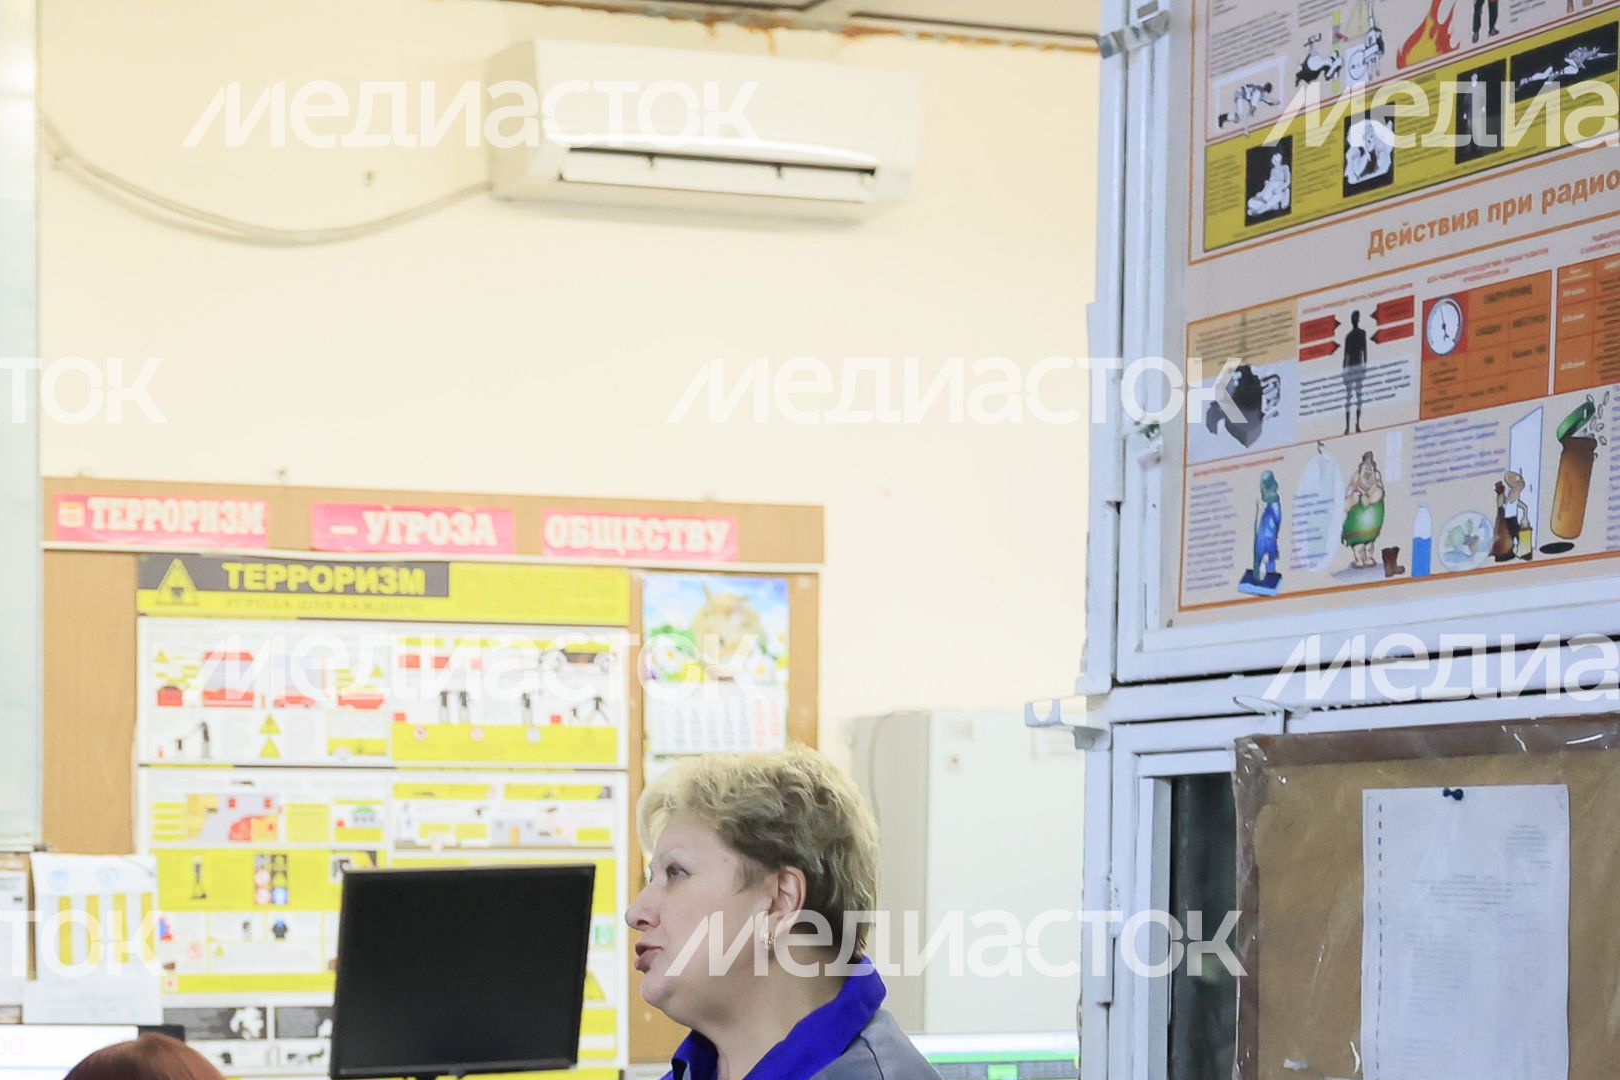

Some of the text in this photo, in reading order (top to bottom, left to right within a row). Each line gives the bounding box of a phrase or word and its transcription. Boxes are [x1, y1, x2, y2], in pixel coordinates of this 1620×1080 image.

[1367, 209, 1480, 260] Действия
[1487, 193, 1533, 226] при
[86, 496, 267, 536] ТЕРРОРИЗМ
[361, 509, 498, 547] УГРОЗА
[543, 512, 731, 556] ОБЩЕСТВУ
[221, 561, 427, 596] ТЕРРОРИЗМ
